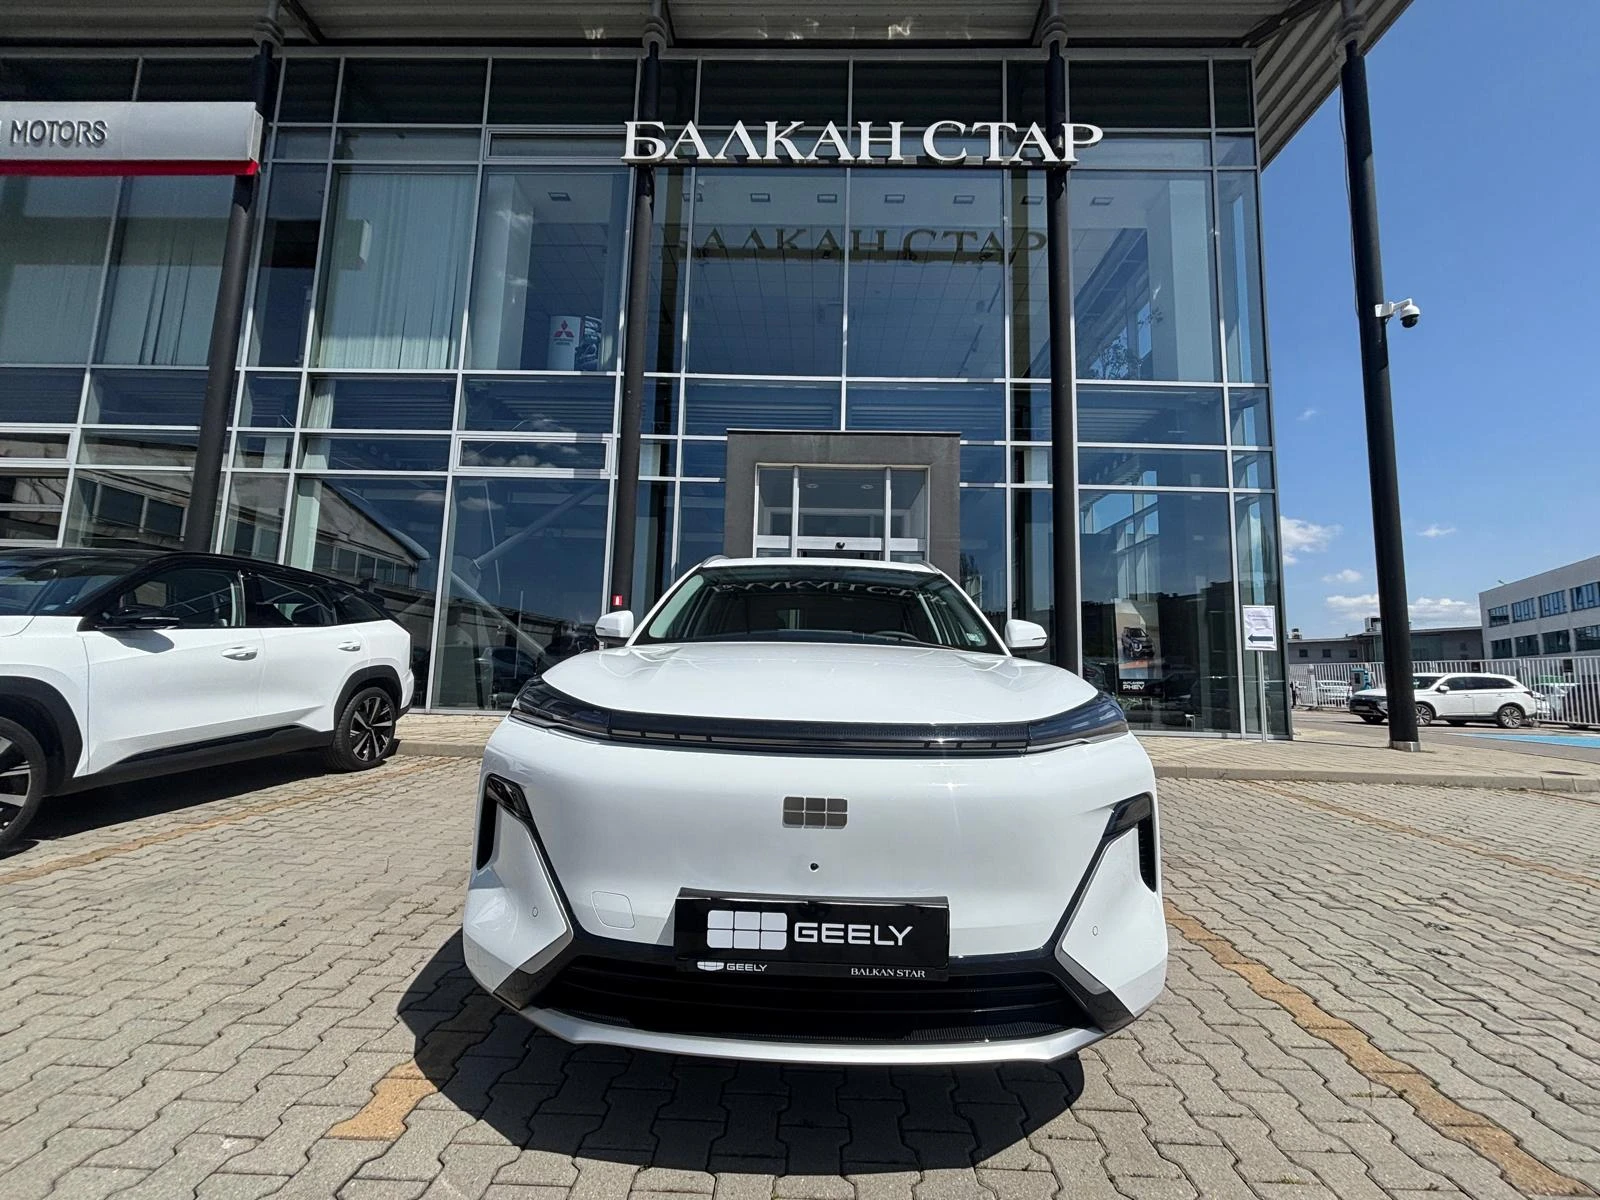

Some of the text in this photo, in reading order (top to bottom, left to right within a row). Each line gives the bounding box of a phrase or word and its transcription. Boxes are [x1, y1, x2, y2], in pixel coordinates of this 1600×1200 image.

[10, 119, 109, 145] MOTORS
[620, 119, 1105, 164] БАЛКАН СТАР
[794, 922, 912, 946] GEELY
[726, 963, 768, 972] GEELY
[851, 967, 926, 978] BALKAN STAR
